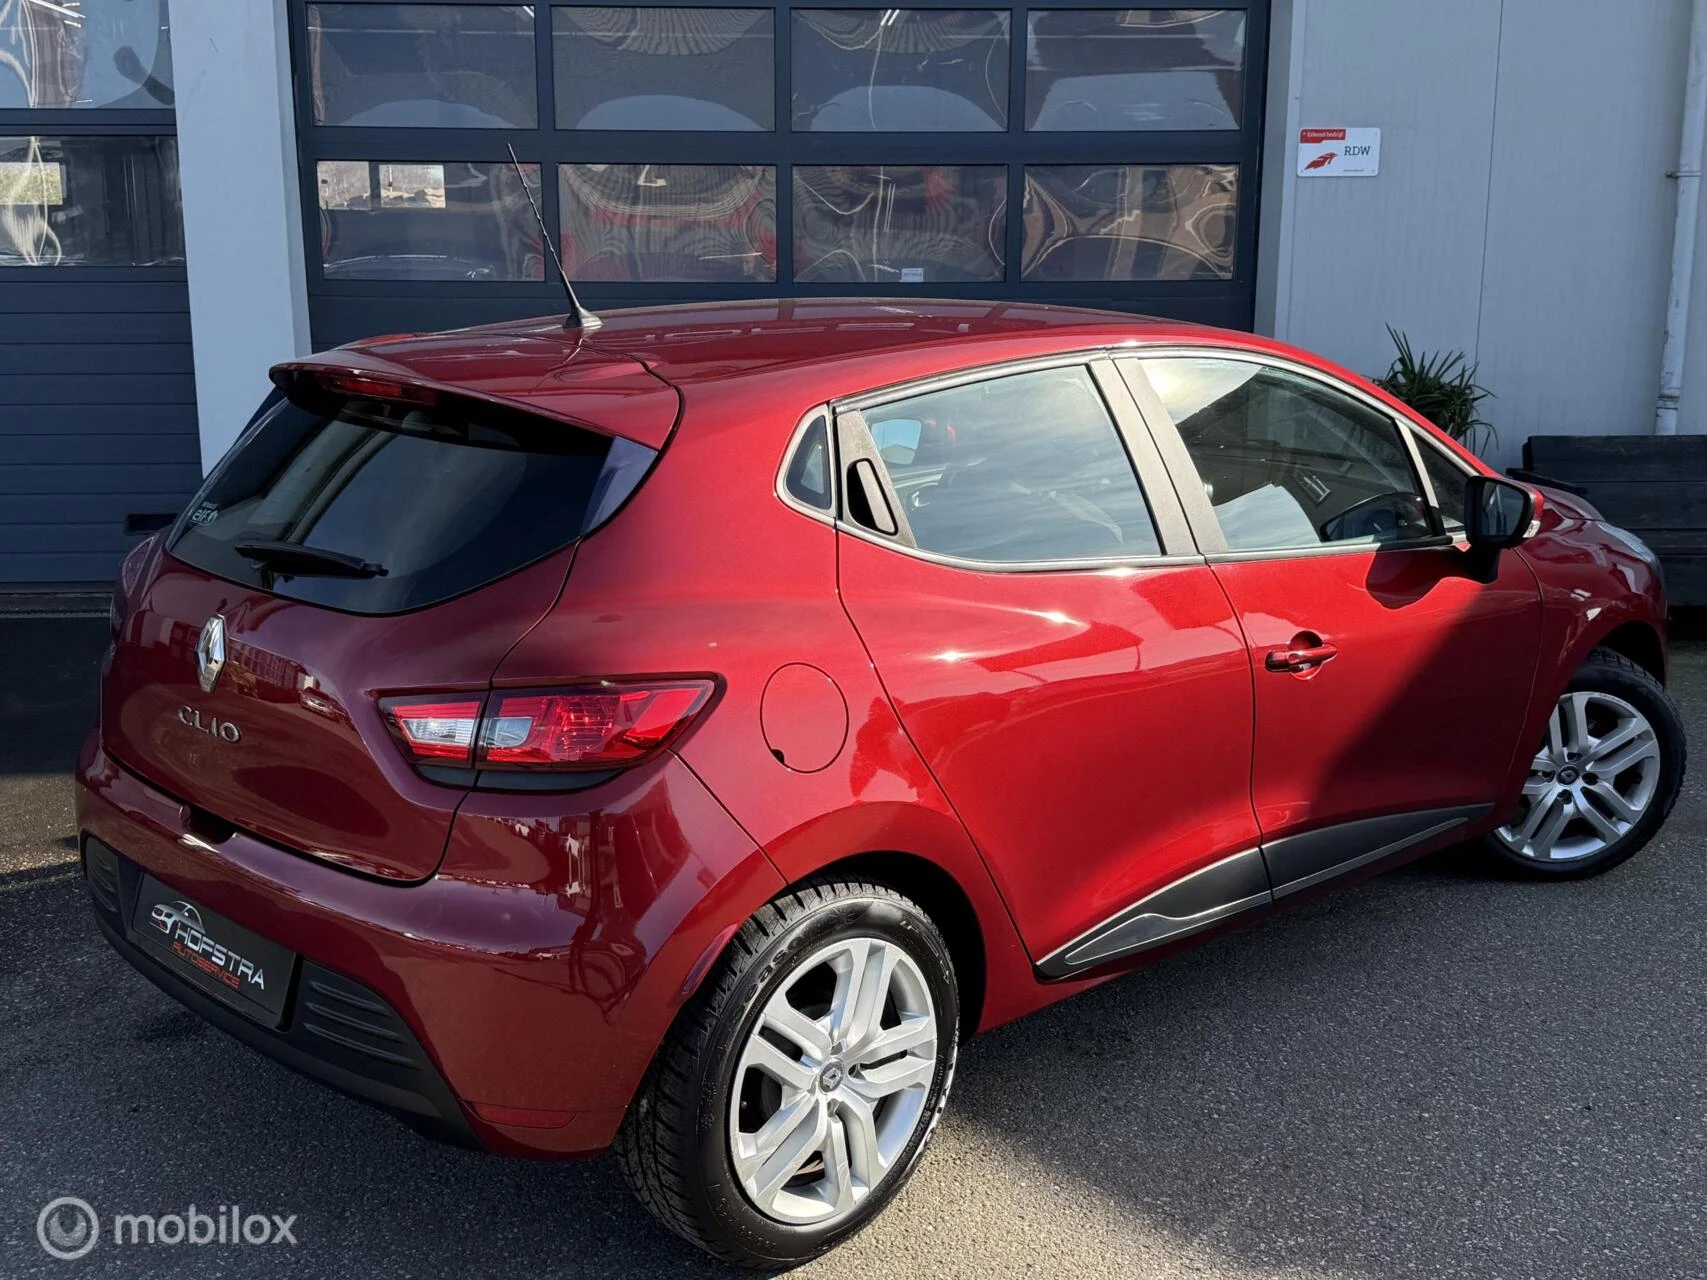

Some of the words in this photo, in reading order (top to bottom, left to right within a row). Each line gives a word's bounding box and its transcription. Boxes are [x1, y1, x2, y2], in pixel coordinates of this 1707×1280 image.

[1344, 146, 1371, 156] RDW
[179, 705, 241, 742] CLIO
[172, 941, 241, 989] AUTOSERVICE
[174, 921, 265, 990] HOFSTRA
